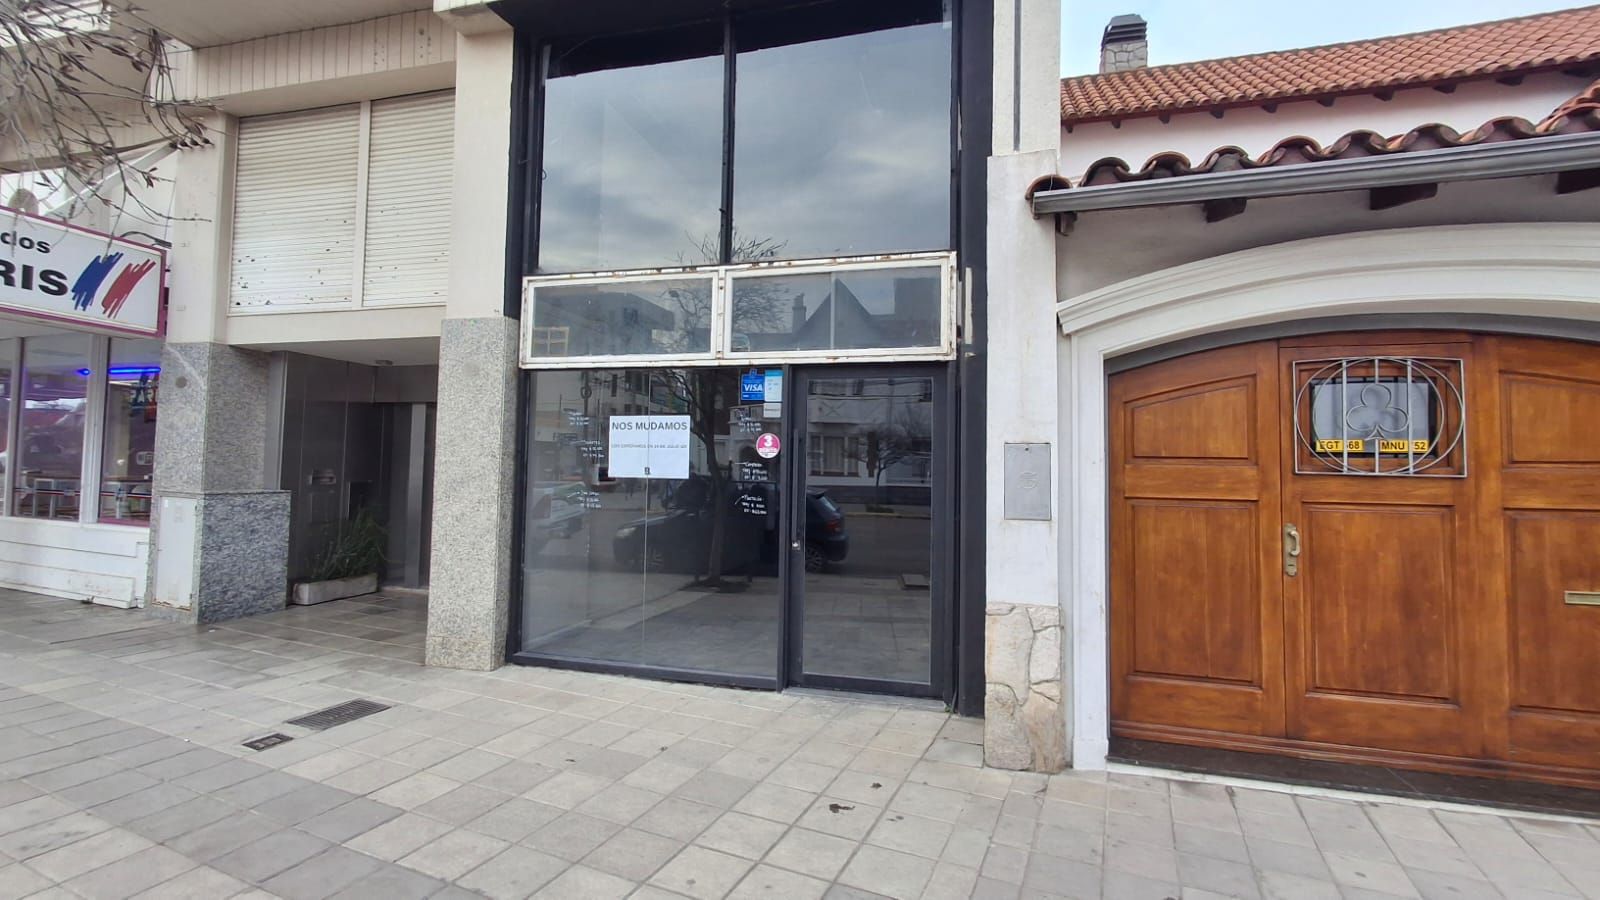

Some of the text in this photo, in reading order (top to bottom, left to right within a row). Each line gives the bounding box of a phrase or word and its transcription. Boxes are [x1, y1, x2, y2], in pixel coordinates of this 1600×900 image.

[743, 383, 763, 391] VISA
[612, 421, 688, 431] NOS MUDAMOS
[763, 435, 773, 447] 3
[1319, 440, 1360, 450] EGT 68
[1381, 440, 1426, 450] MNU 52
